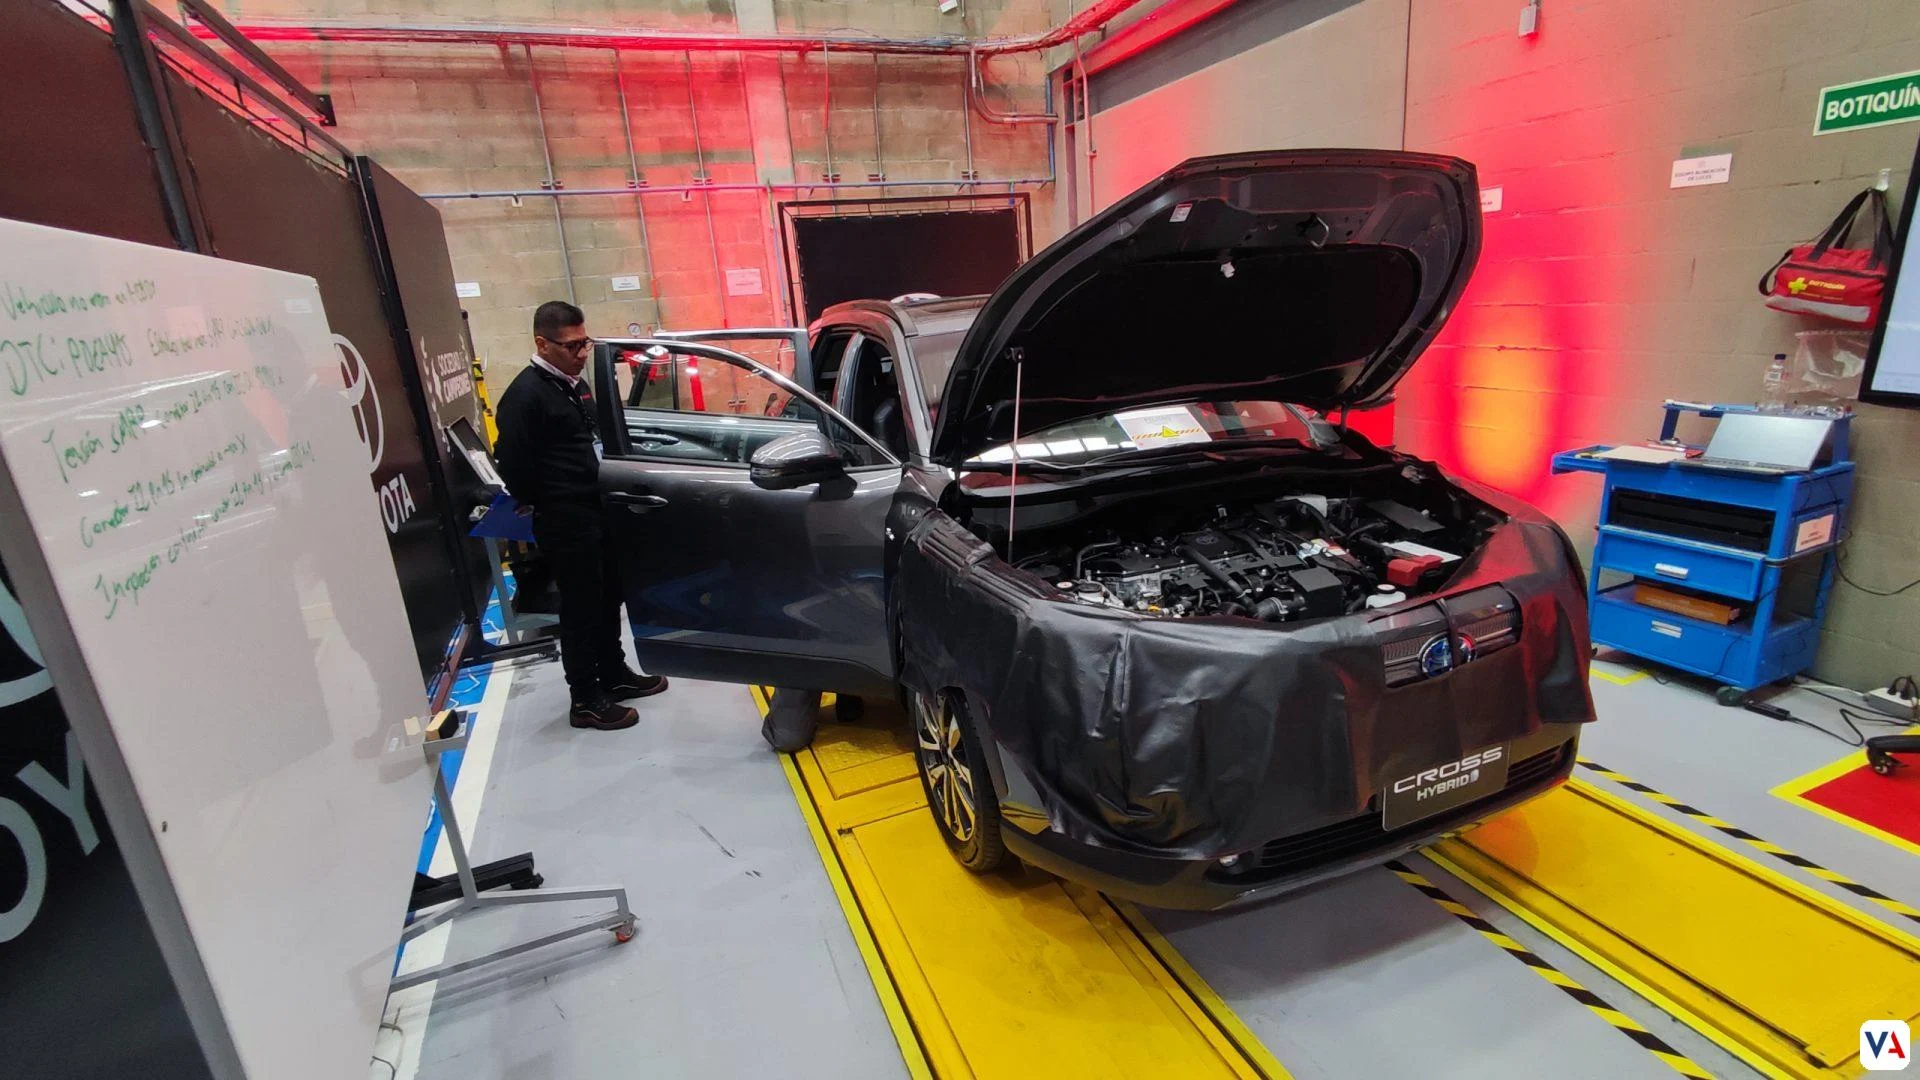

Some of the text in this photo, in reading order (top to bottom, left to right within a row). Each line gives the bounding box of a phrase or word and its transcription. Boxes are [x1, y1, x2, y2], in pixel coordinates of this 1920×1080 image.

[1825, 82, 1920, 121] BOTIQUÍN
[1393, 747, 1503, 795] CROSS
[1416, 775, 1471, 802] HYBRID
